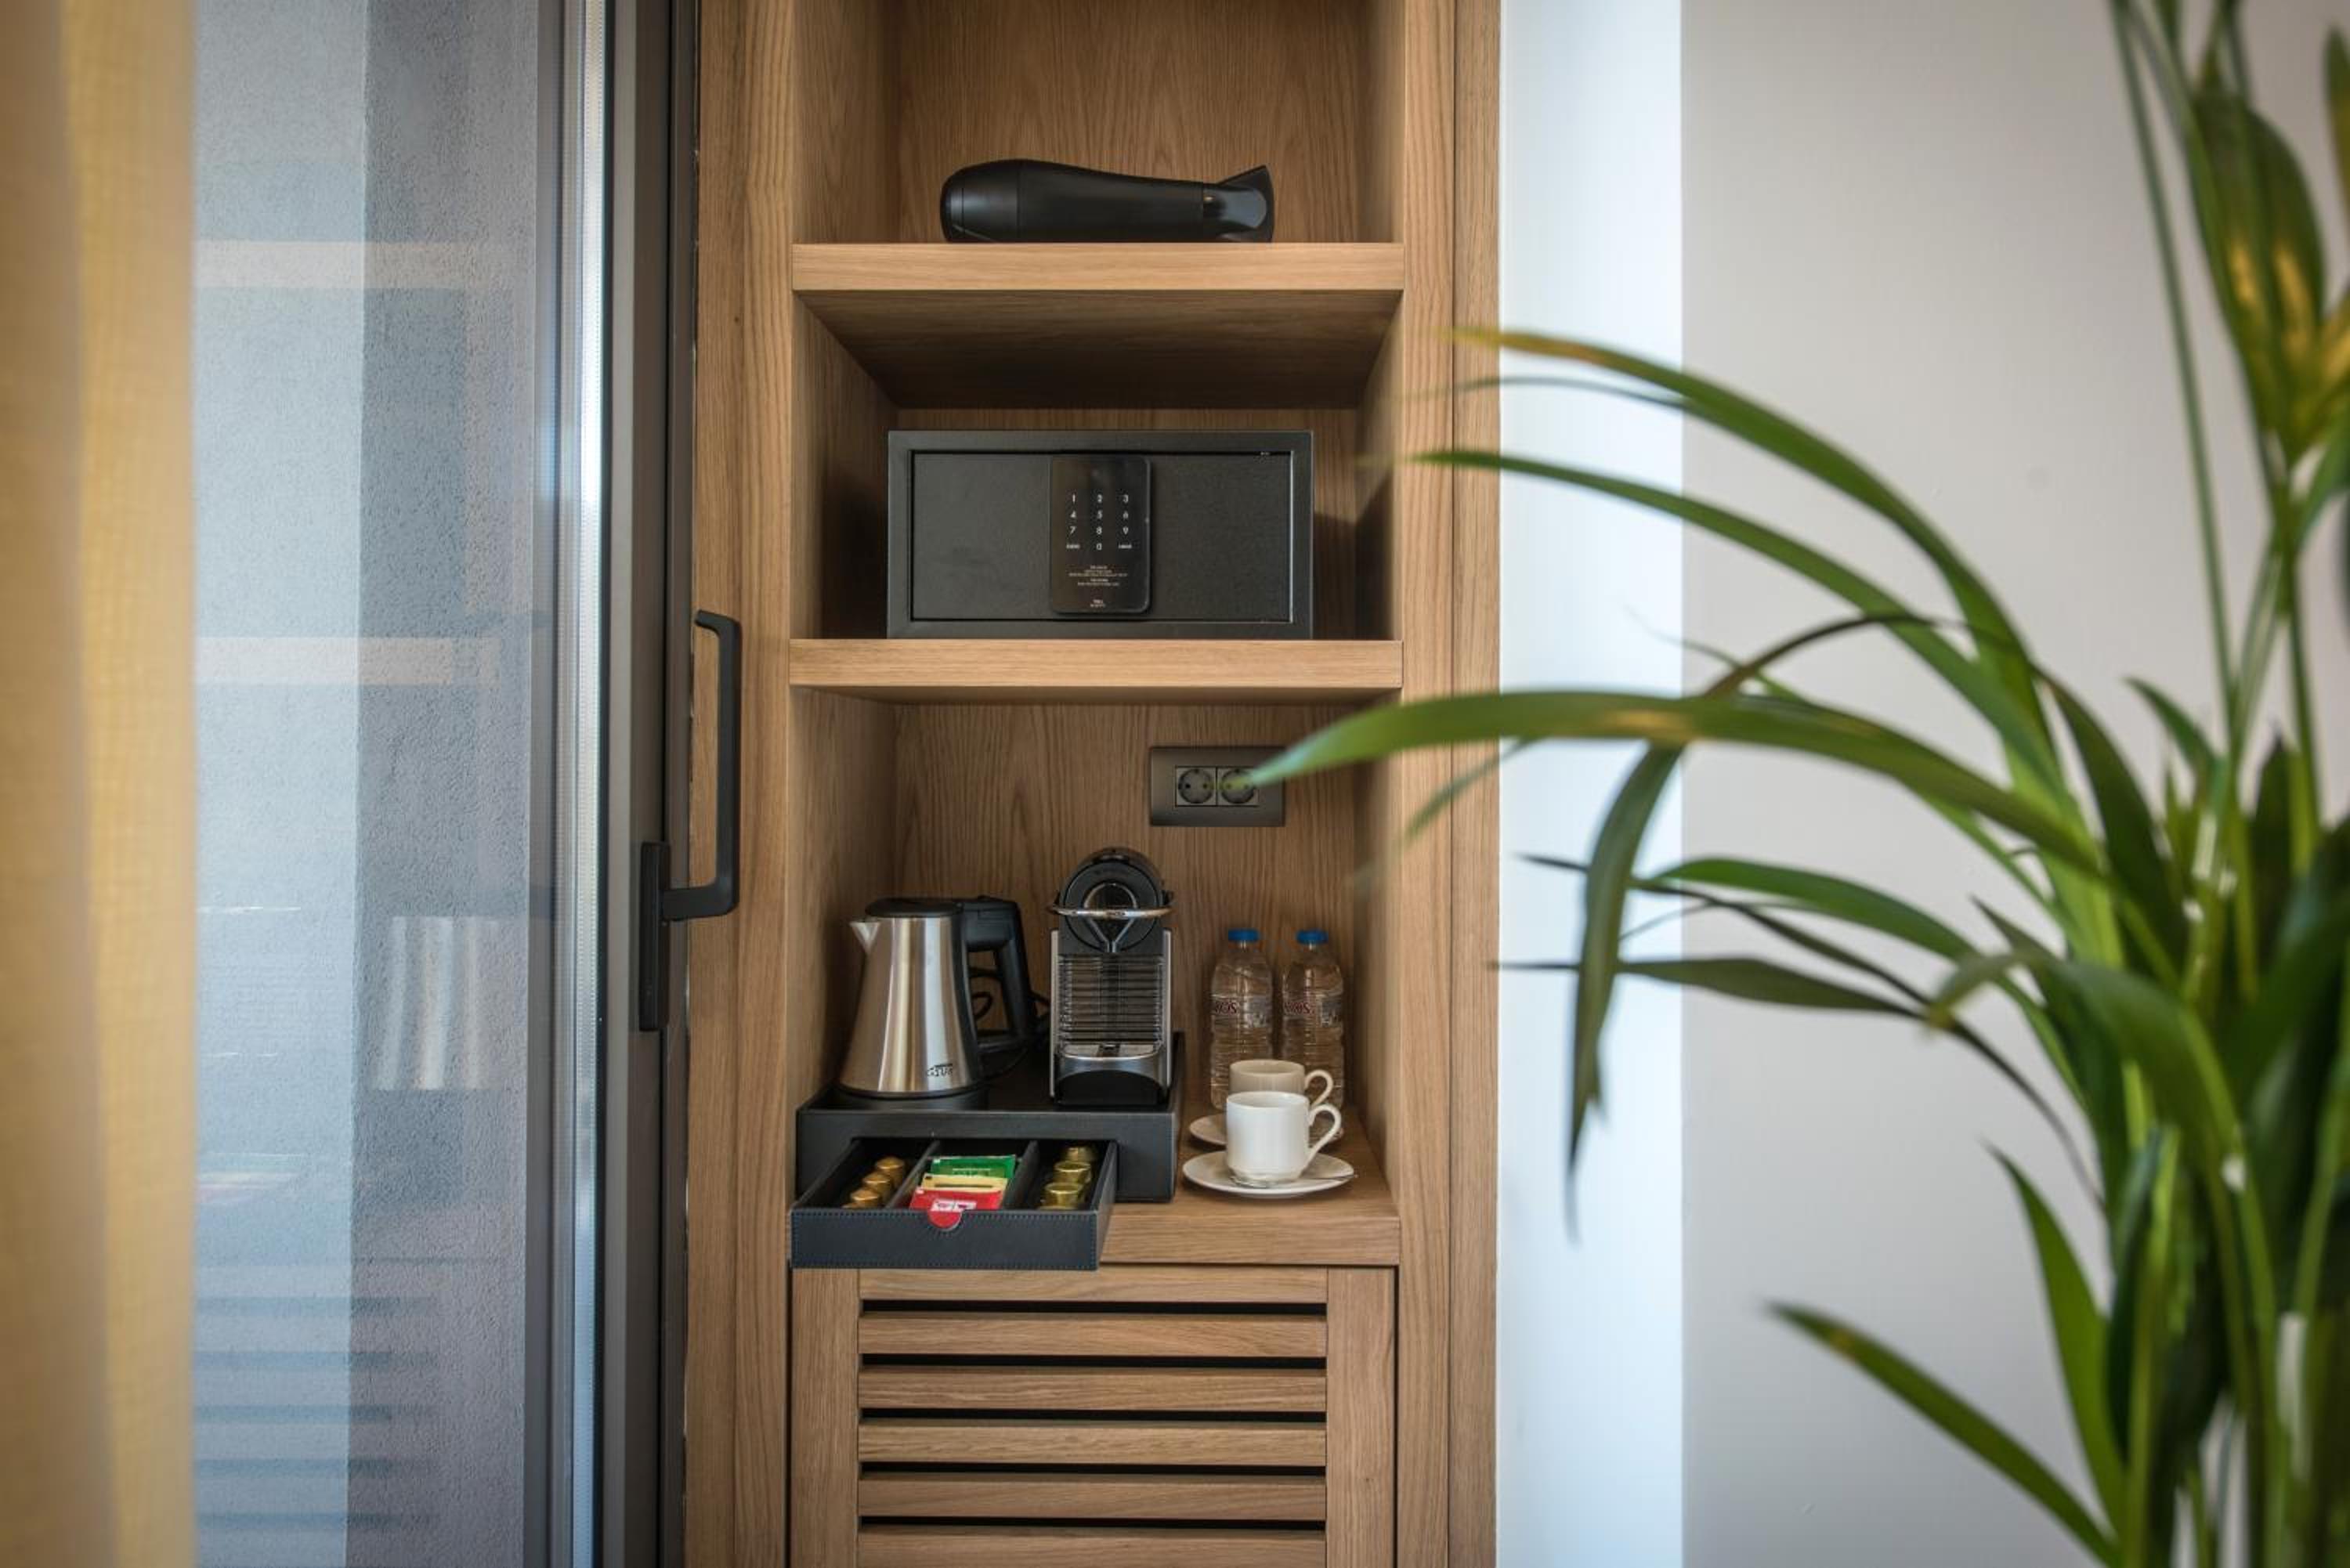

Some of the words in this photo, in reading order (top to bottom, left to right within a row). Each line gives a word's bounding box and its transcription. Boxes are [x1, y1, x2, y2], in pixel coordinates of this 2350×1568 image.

[1072, 493, 1076, 504] 1
[1097, 494, 1103, 504] 2
[1123, 494, 1129, 504] 3
[1070, 510, 1076, 518] 4
[1097, 510, 1103, 519] 5
[1123, 511, 1129, 519] 6
[1069, 526, 1076, 534] 7
[1096, 526, 1102, 535] 8
[1123, 526, 1129, 535] 9
[1096, 542, 1102, 551] 0
